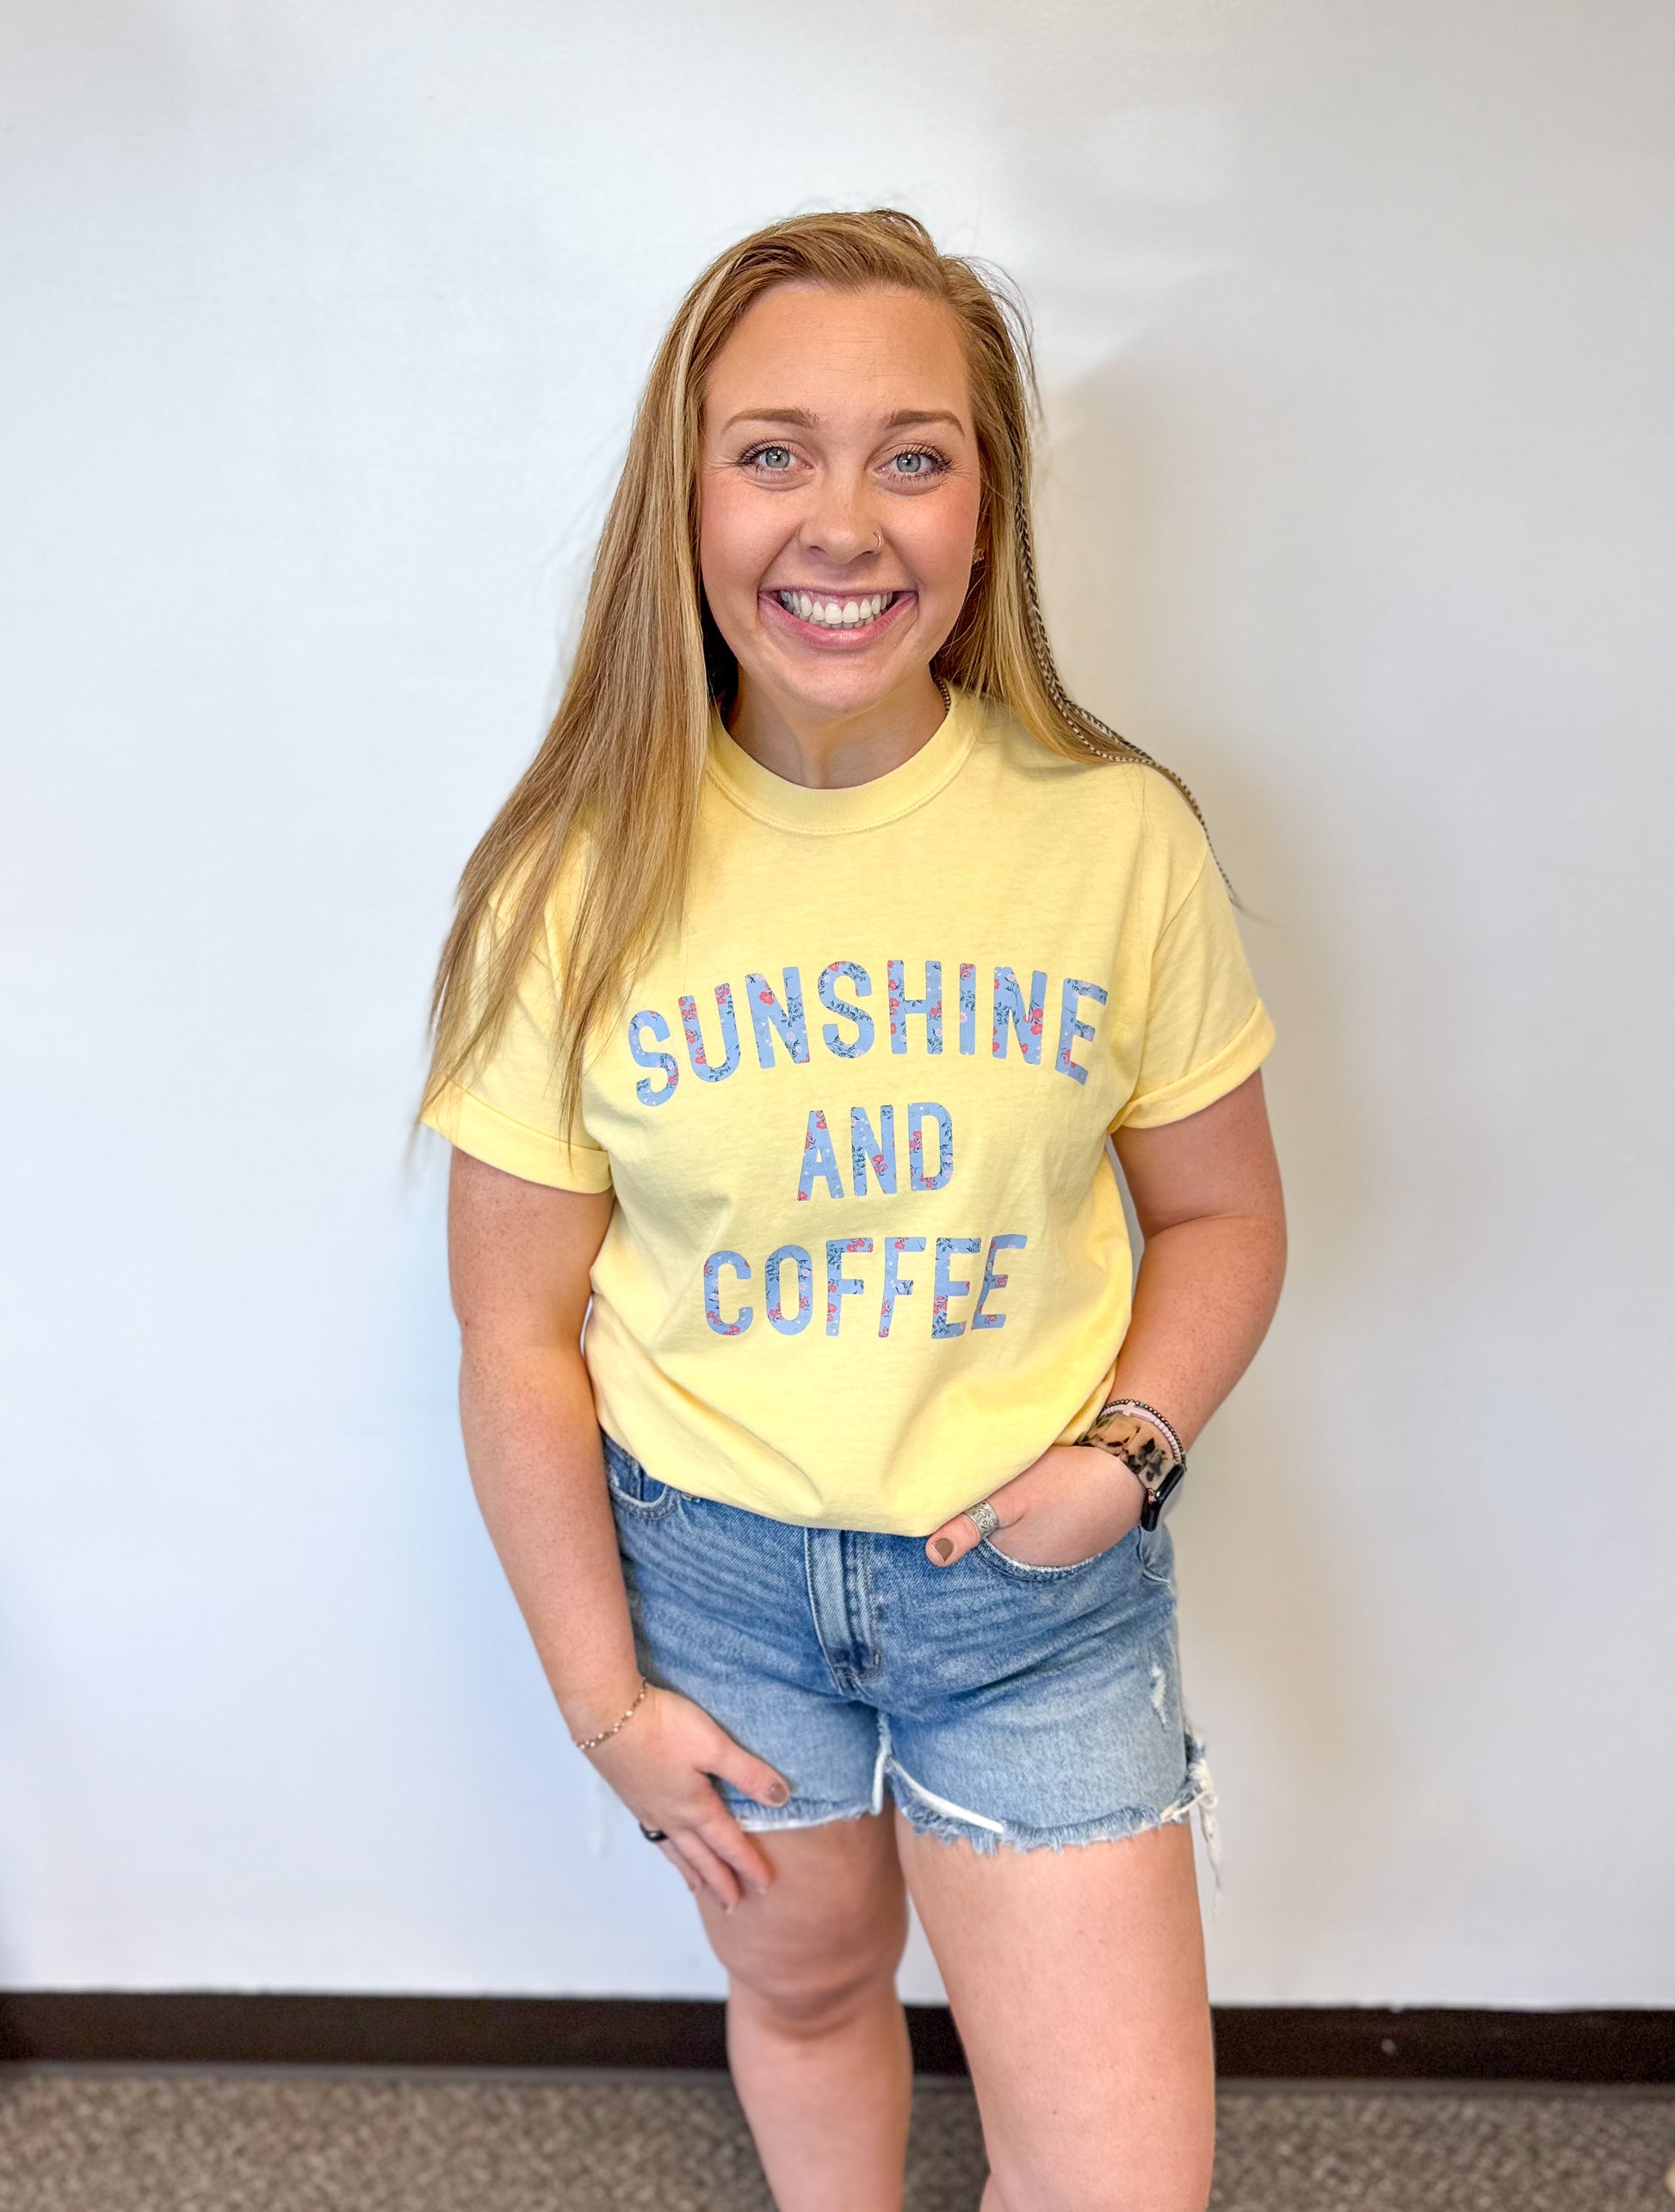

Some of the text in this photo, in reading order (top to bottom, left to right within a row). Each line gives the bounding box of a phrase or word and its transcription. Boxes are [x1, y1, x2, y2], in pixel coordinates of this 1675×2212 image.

[627, 960, 1109, 1108] SUNSHINE
[796, 1102, 954, 1202] AND
[702, 1233, 1028, 1340] COFFEE
